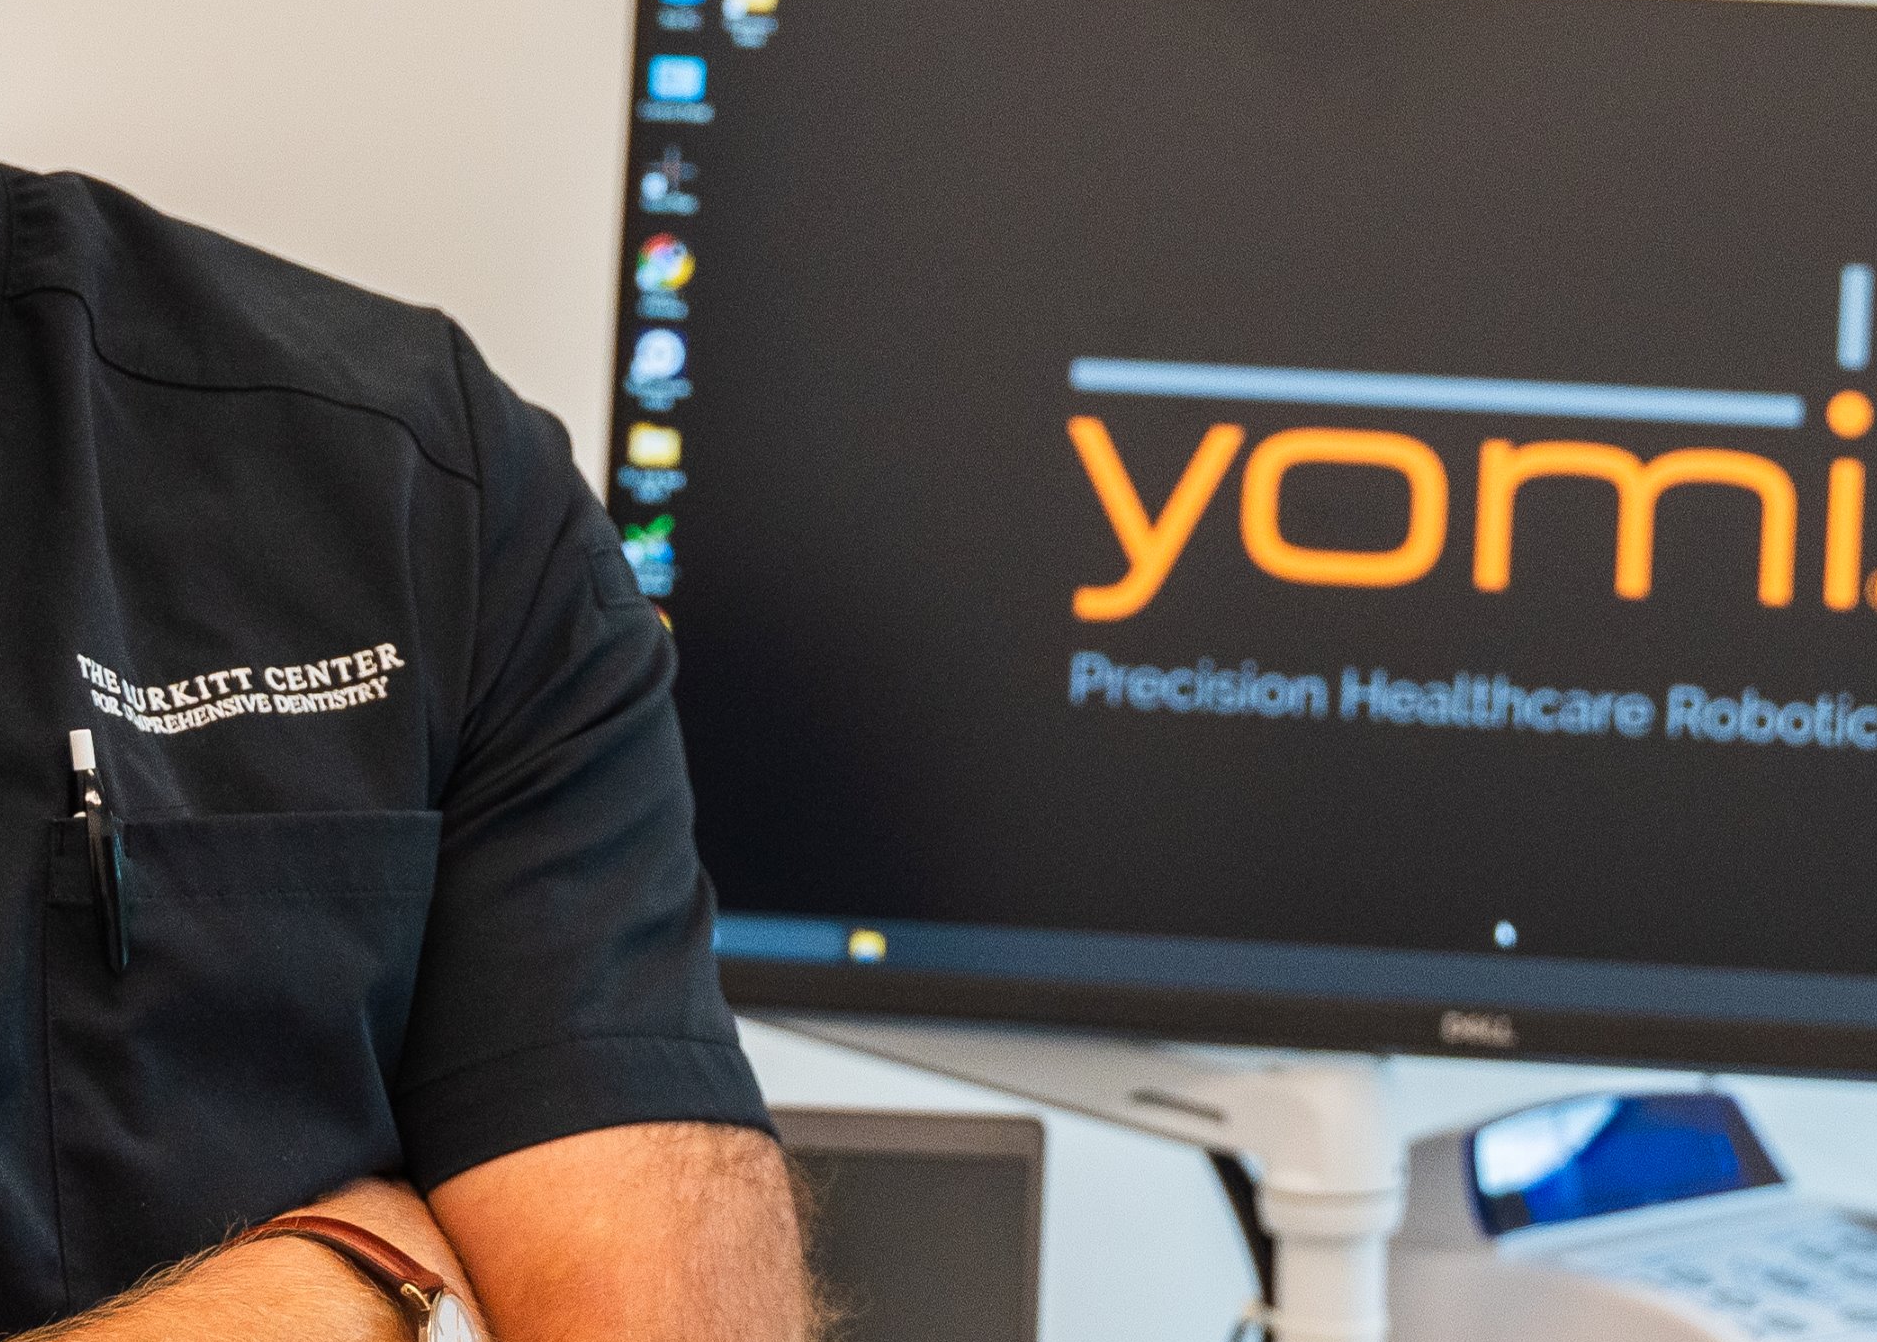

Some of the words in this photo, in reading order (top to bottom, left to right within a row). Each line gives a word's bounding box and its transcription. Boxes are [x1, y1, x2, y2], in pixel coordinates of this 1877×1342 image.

[1066, 389, 1874, 623] yomi
[76, 653, 121, 695] THE
[264, 642, 405, 692] CENTER
[122, 692, 273, 734] OMPREHENSIVE
[272, 675, 389, 715] DENTISTRY
[1070, 649, 1329, 719] Precision
[1339, 665, 1655, 739] Healthcare
